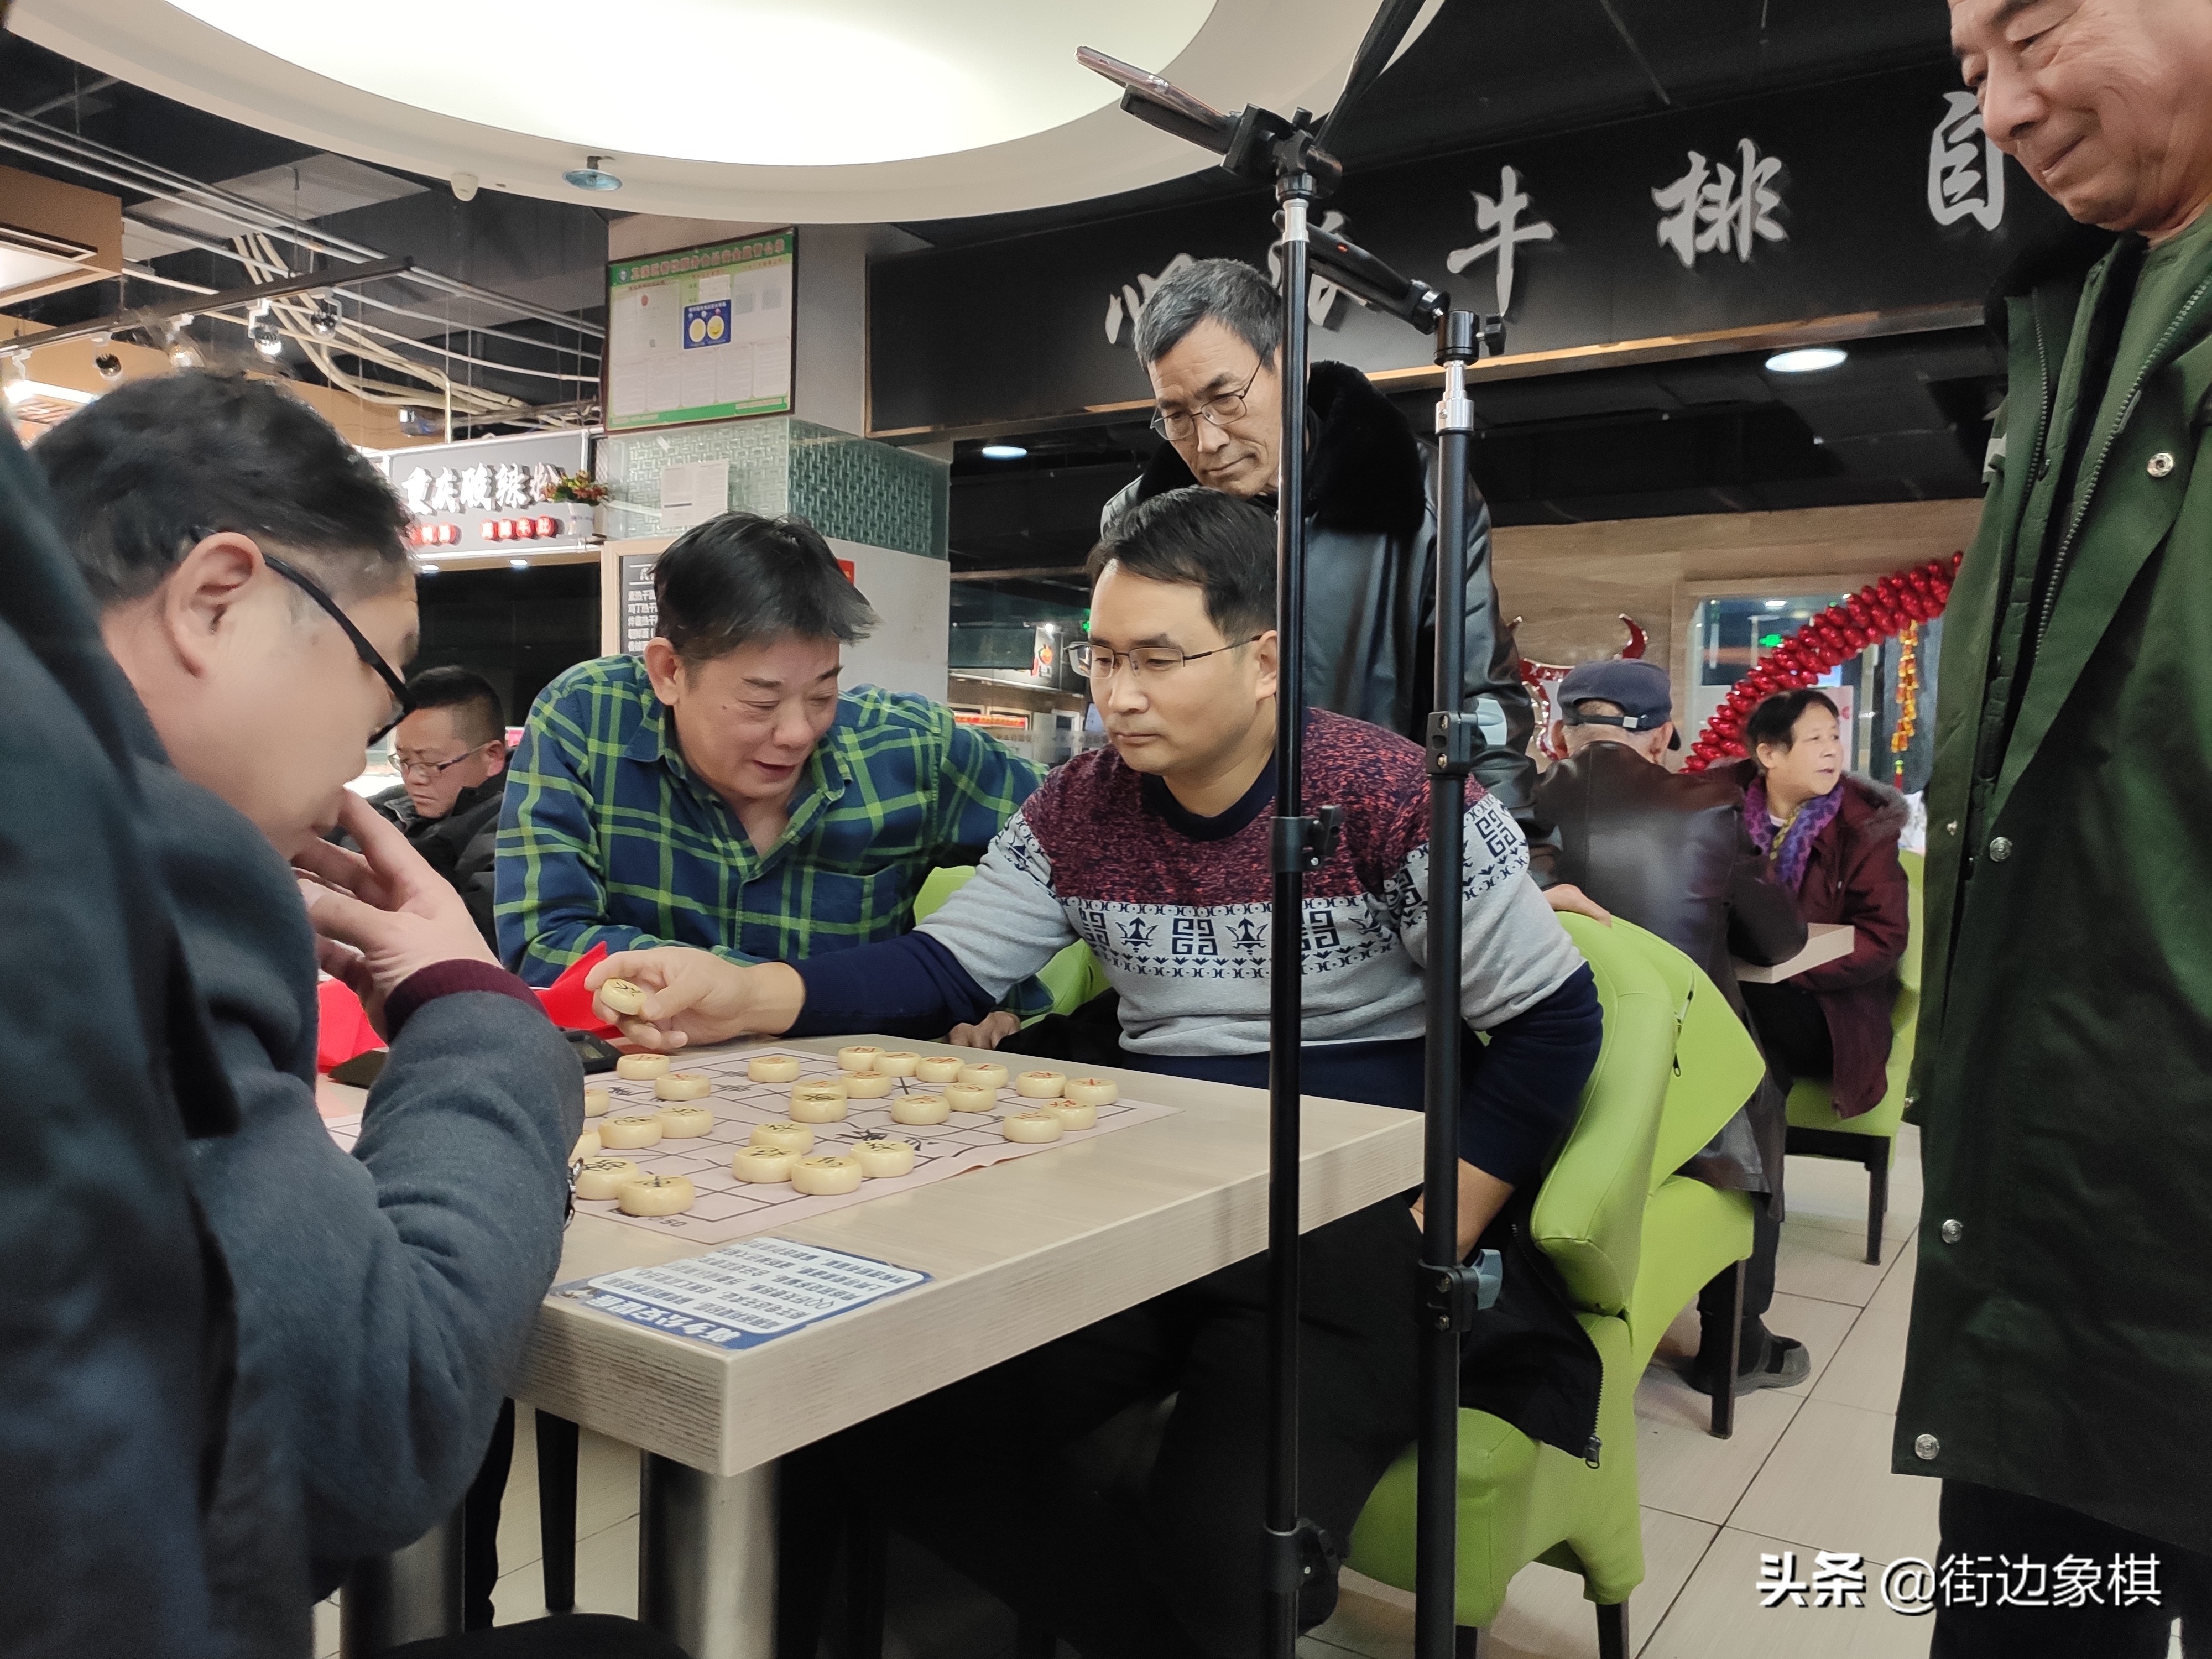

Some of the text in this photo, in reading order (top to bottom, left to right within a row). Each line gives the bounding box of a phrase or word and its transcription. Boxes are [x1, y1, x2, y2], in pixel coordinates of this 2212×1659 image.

[586, 1295, 743, 1343] 新乡公安提醒
